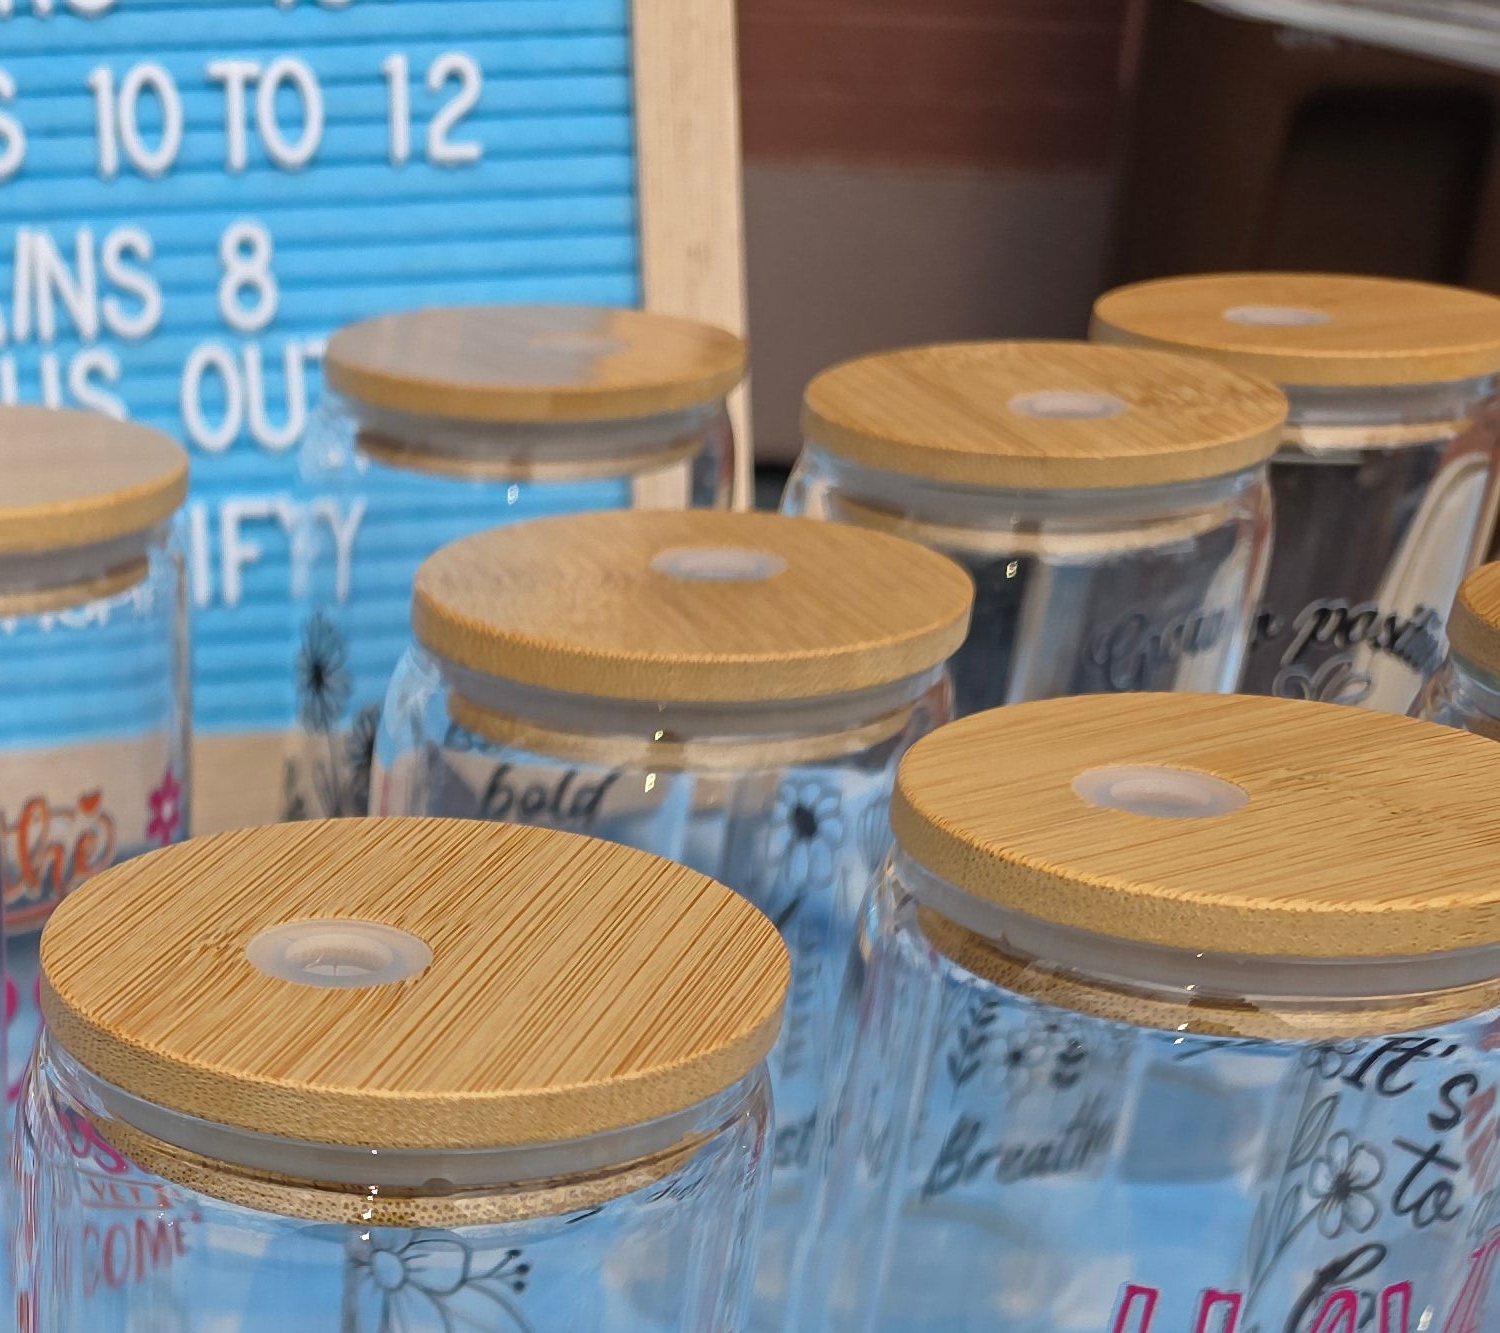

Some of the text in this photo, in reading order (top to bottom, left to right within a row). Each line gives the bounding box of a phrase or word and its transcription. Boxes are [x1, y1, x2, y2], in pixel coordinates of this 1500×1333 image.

[88, 62, 184, 178] 10
[206, 58, 325, 174] TO
[383, 53, 483, 164] 12
[218, 221, 280, 333] 8
[181, 343, 322, 452] OU
